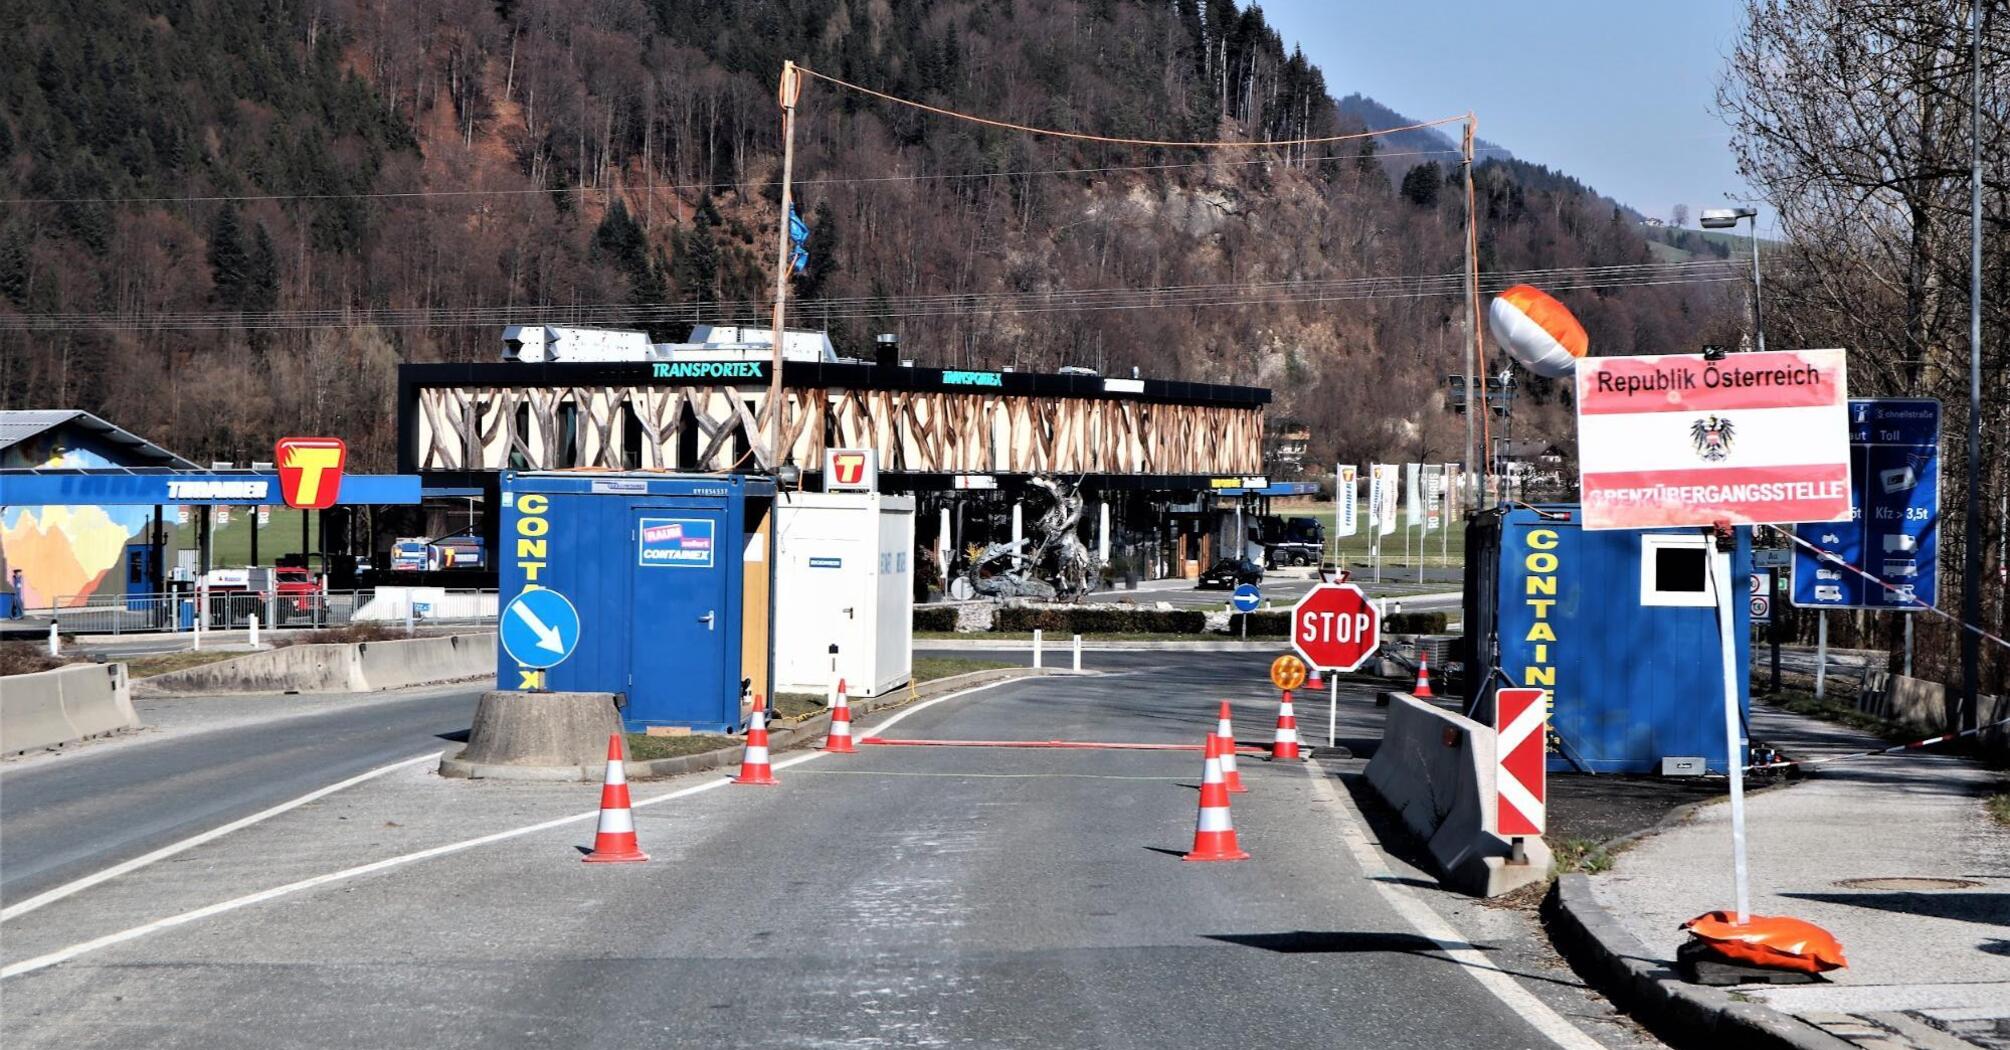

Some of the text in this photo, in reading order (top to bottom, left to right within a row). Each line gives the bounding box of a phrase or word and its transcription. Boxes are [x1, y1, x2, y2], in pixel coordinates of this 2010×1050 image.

[652, 362, 763, 378] TRANSPORTEX
[1597, 361, 1820, 396] Republik Österreich
[1880, 429, 1900, 442] Toll
[1589, 480, 1845, 506] GRENZÜBERGANGSSTELLE
[1875, 506, 1893, 519] Kfz
[1906, 507, 1929, 522] 3,5t
[643, 549, 711, 560] CONTAINEX
[1302, 611, 1370, 644] STOP
